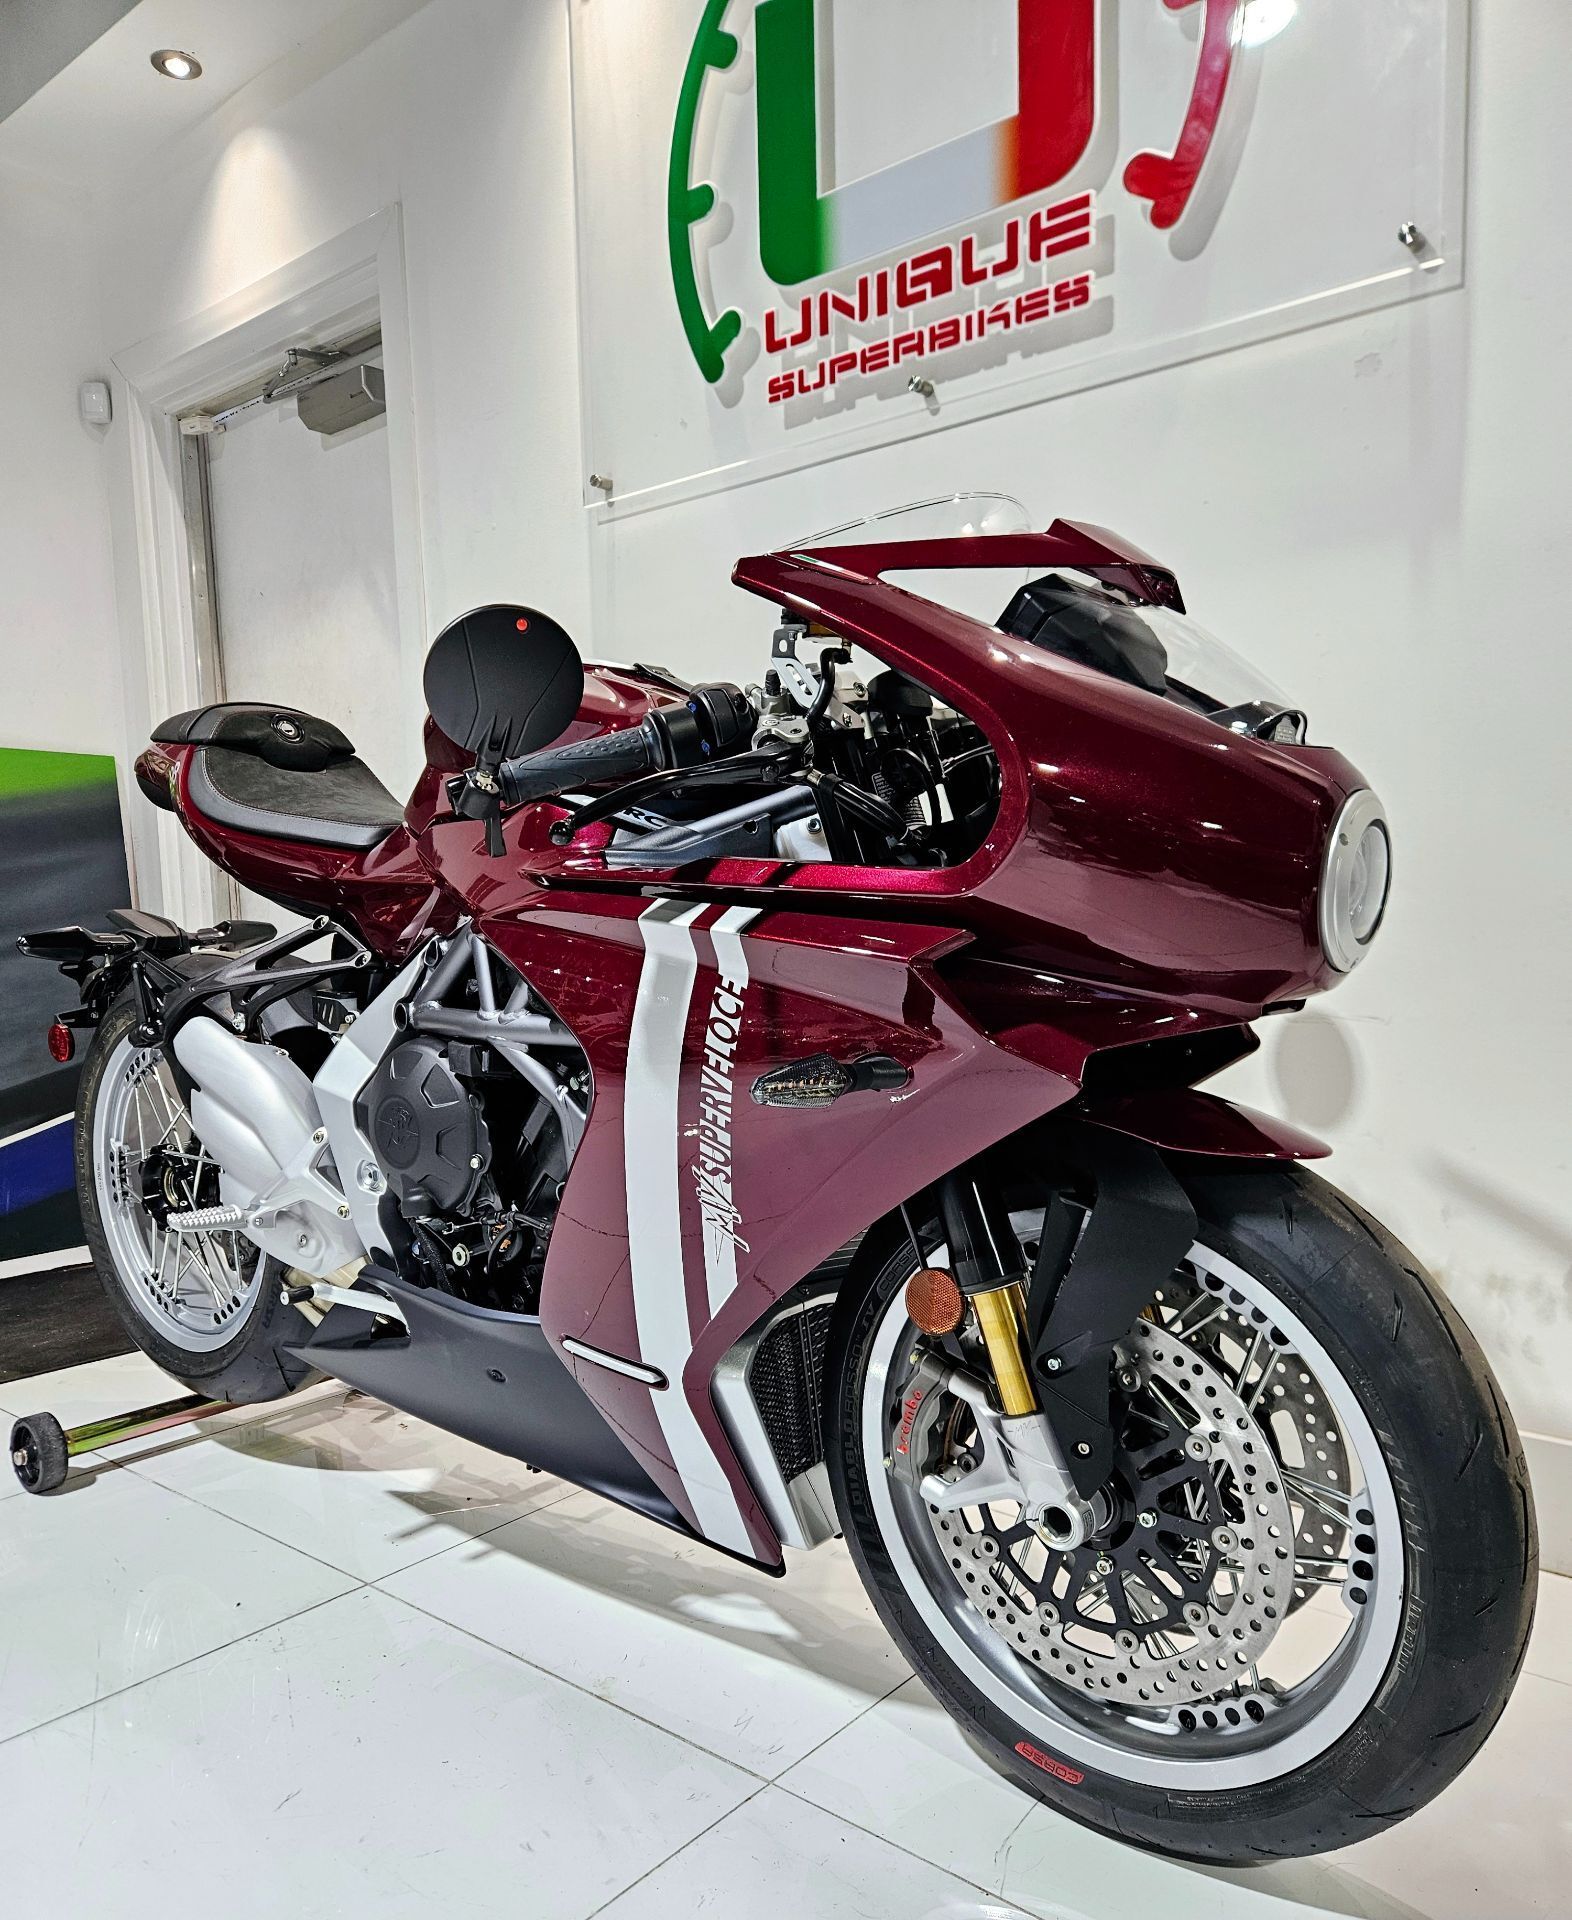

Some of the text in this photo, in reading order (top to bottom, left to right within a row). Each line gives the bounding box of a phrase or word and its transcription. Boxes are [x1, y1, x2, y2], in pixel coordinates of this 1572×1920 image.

[765, 193, 1092, 353] UNIQUE
[768, 275, 1092, 404] SUPERBIKES
[699, 974, 746, 1185] SUPERVELOCE
[898, 1389, 923, 1454] brembo
[1021, 1745, 1079, 1783] CORSA
